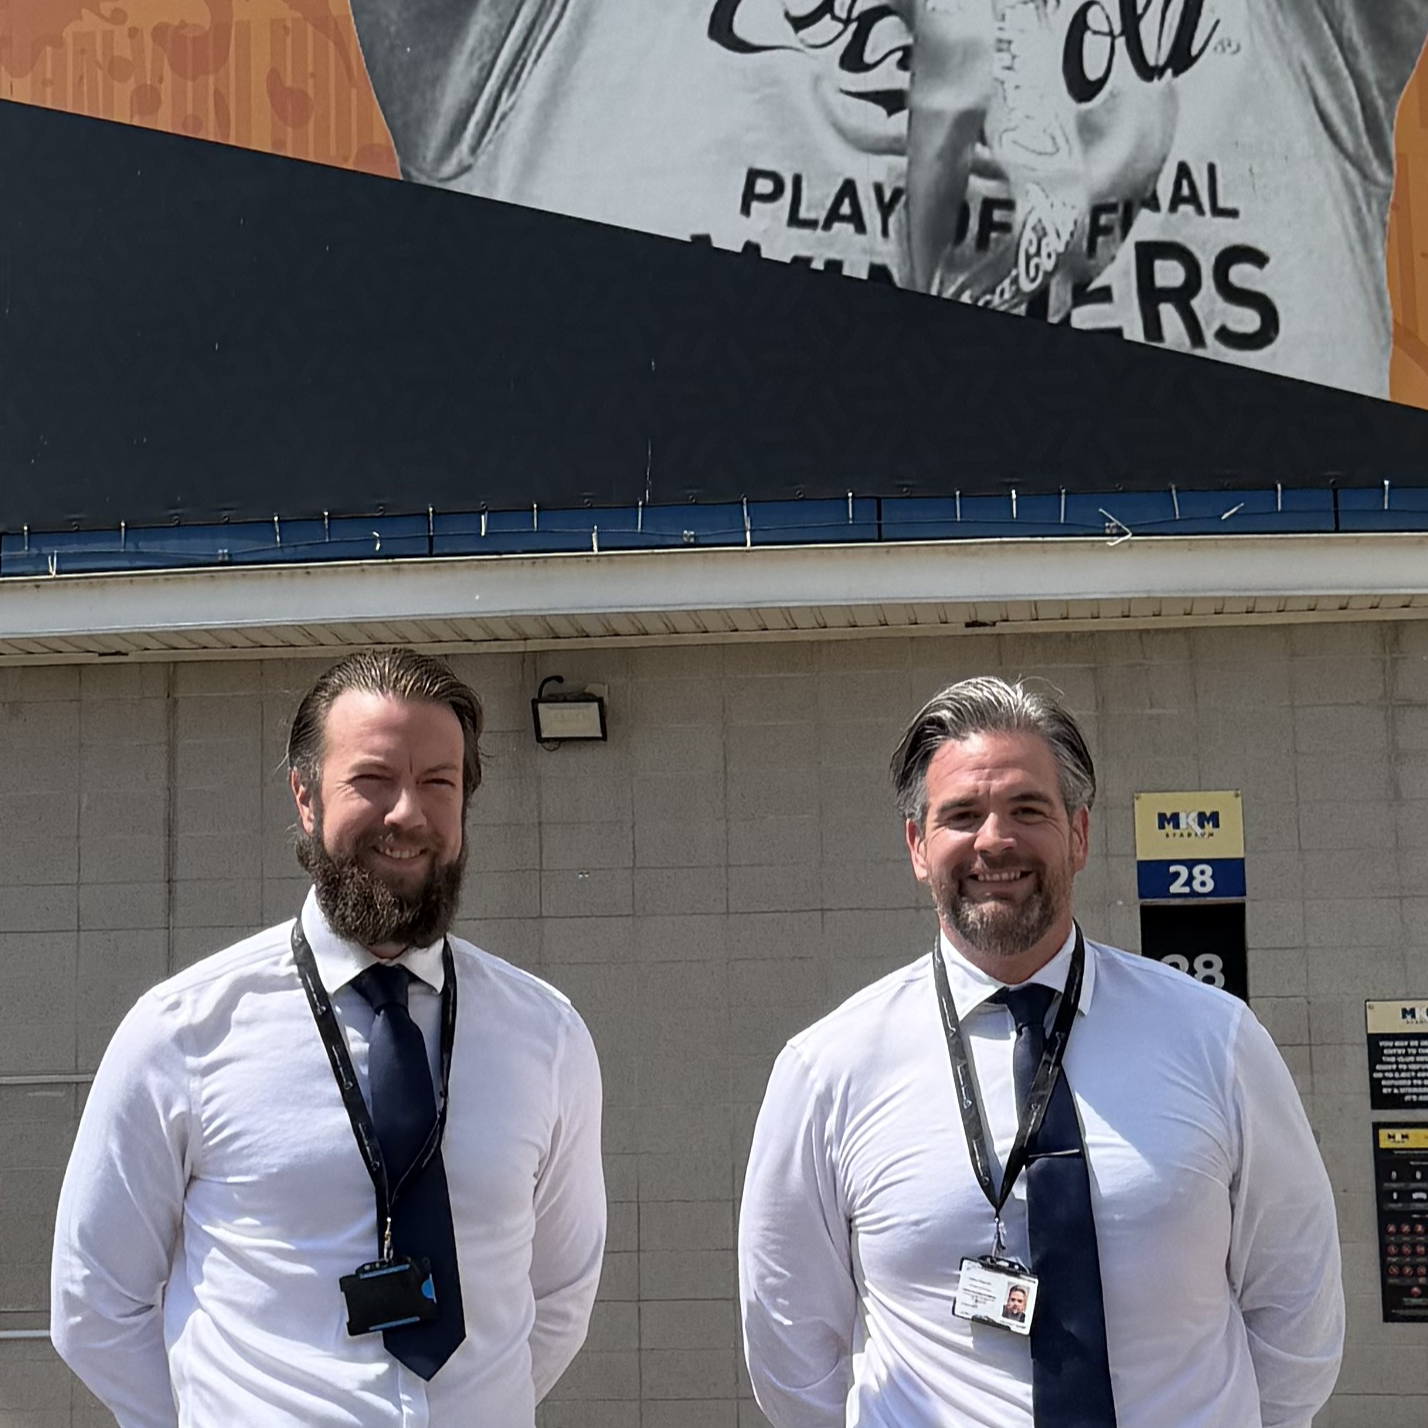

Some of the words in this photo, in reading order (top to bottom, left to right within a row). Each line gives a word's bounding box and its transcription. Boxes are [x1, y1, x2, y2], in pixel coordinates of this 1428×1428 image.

[1087, 161, 1240, 259] FIAL
[1157, 811, 1220, 837] MKM
[1169, 864, 1215, 894] 28
